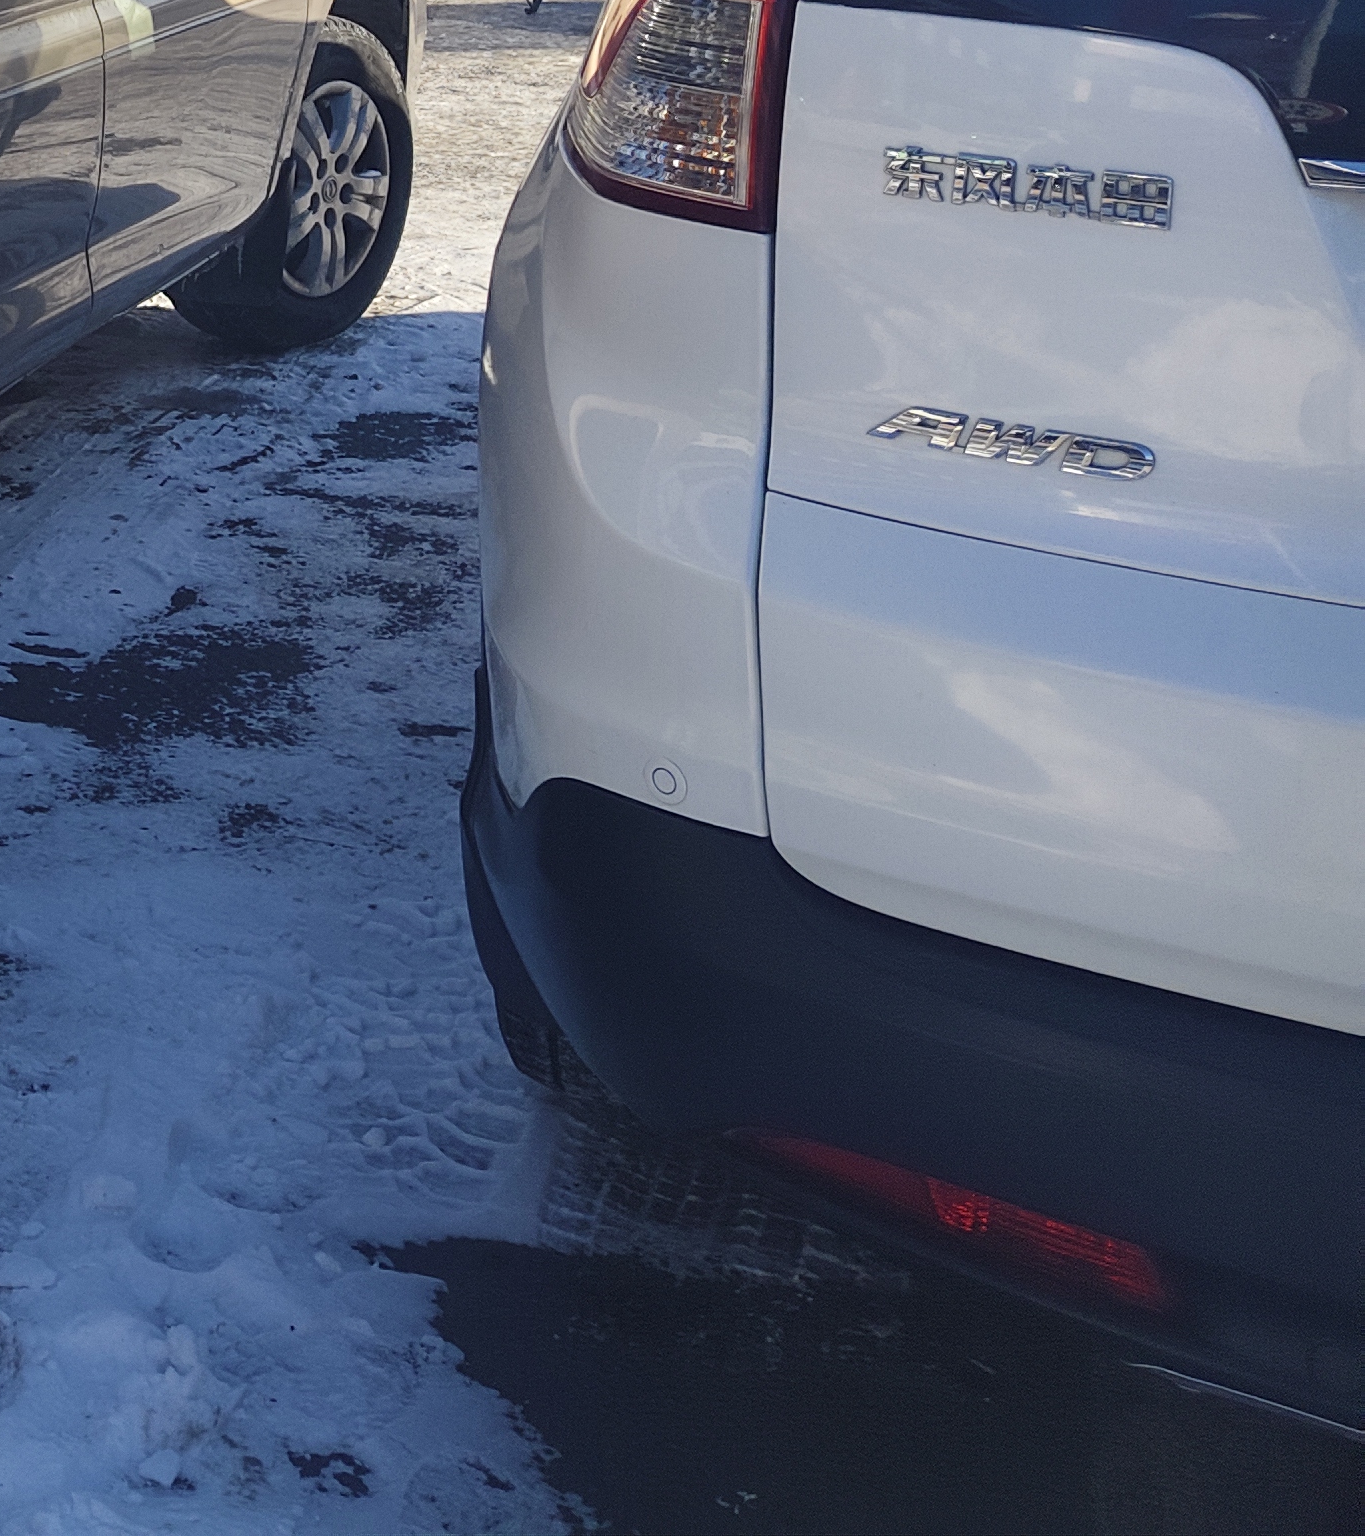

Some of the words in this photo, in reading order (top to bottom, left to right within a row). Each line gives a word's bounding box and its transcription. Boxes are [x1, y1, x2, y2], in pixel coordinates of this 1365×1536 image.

[883, 146, 1174, 230] 东风本田
[866, 406, 1156, 481] AWD
